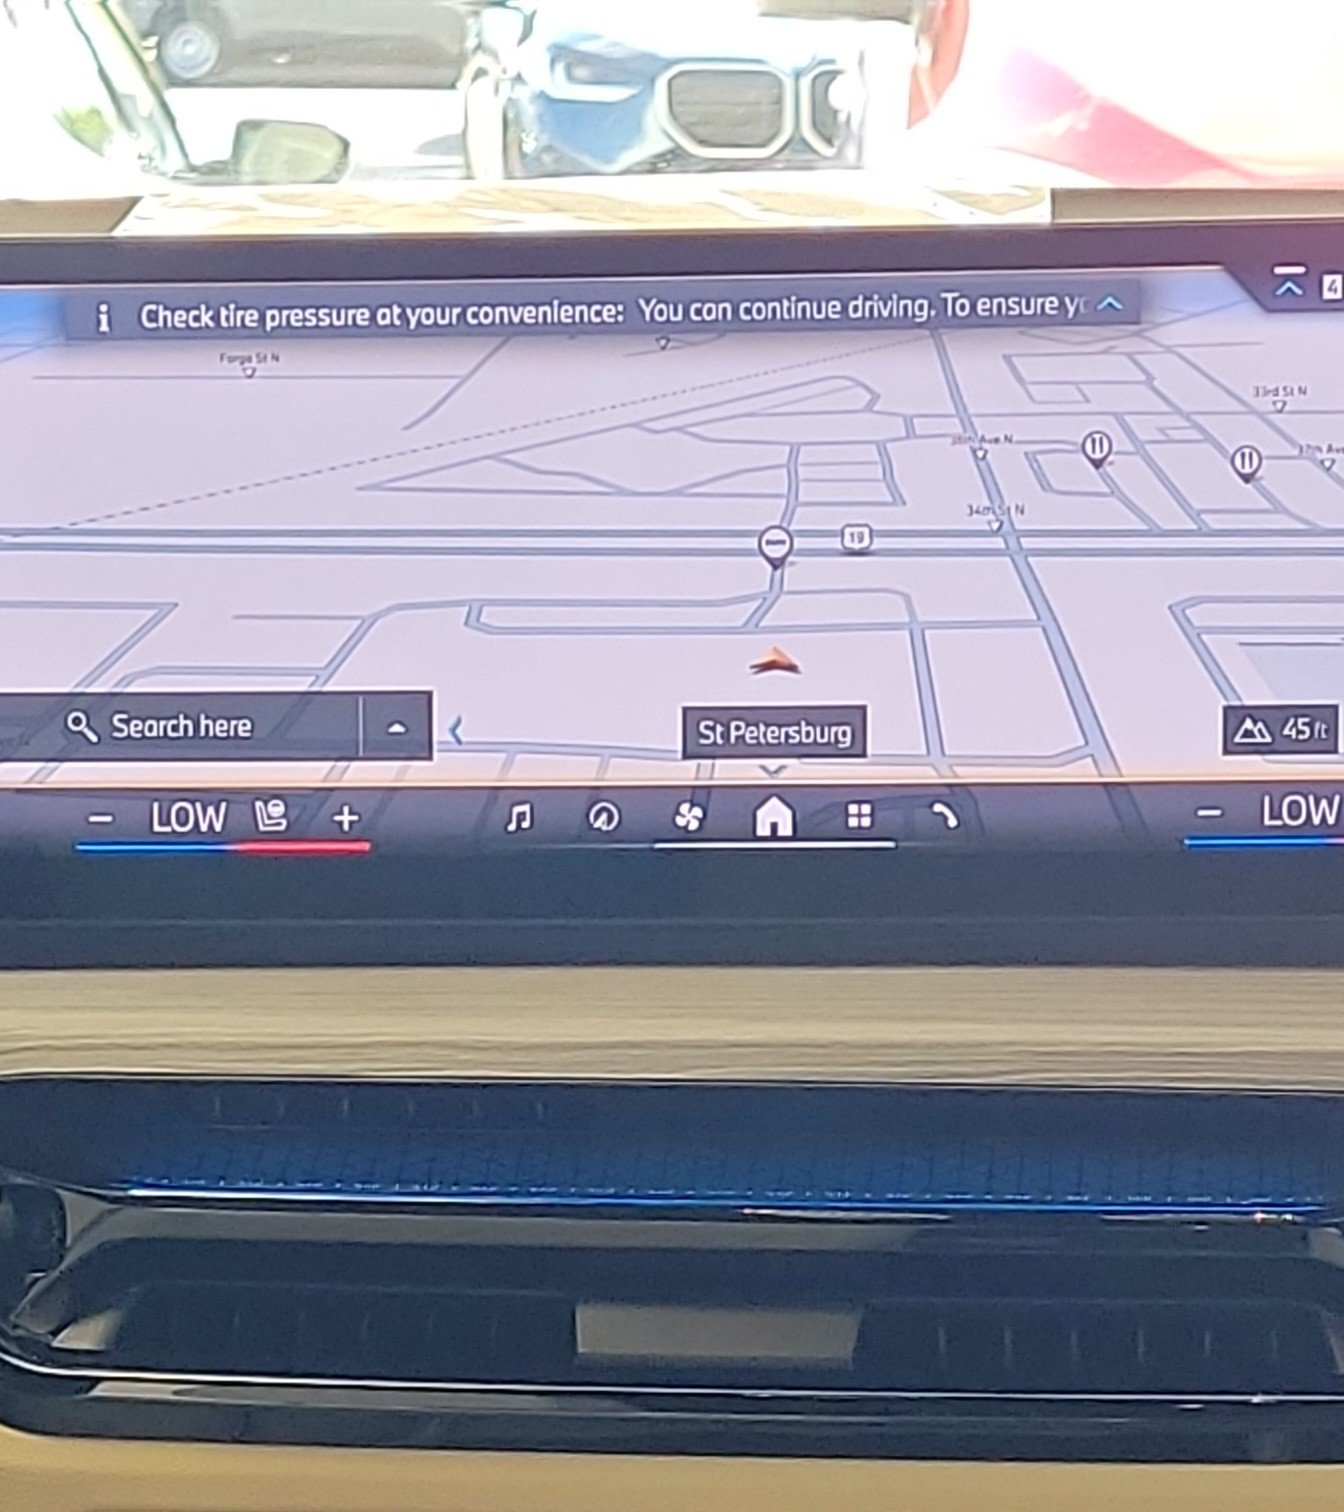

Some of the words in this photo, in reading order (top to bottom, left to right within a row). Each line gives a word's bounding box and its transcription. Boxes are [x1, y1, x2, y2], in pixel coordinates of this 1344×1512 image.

[140, 302, 216, 329] Check
[219, 303, 259, 328] tire
[265, 305, 370, 331] pressure
[375, 304, 404, 327] at
[406, 306, 462, 331] your
[465, 299, 625, 327] convenience:
[637, 297, 684, 323] You
[688, 303, 732, 322] can
[738, 295, 842, 320] continue
[849, 293, 936, 322] driving.
[940, 292, 972, 318] To
[976, 296, 1060, 317] ensure
[109, 711, 195, 740] Search
[198, 712, 253, 739] here
[697, 720, 724, 746] St
[729, 719, 853, 748] Petersburg
[1282, 717, 1311, 740] 45
[152, 801, 227, 833] LOW
[1263, 795, 1341, 827] LOW
